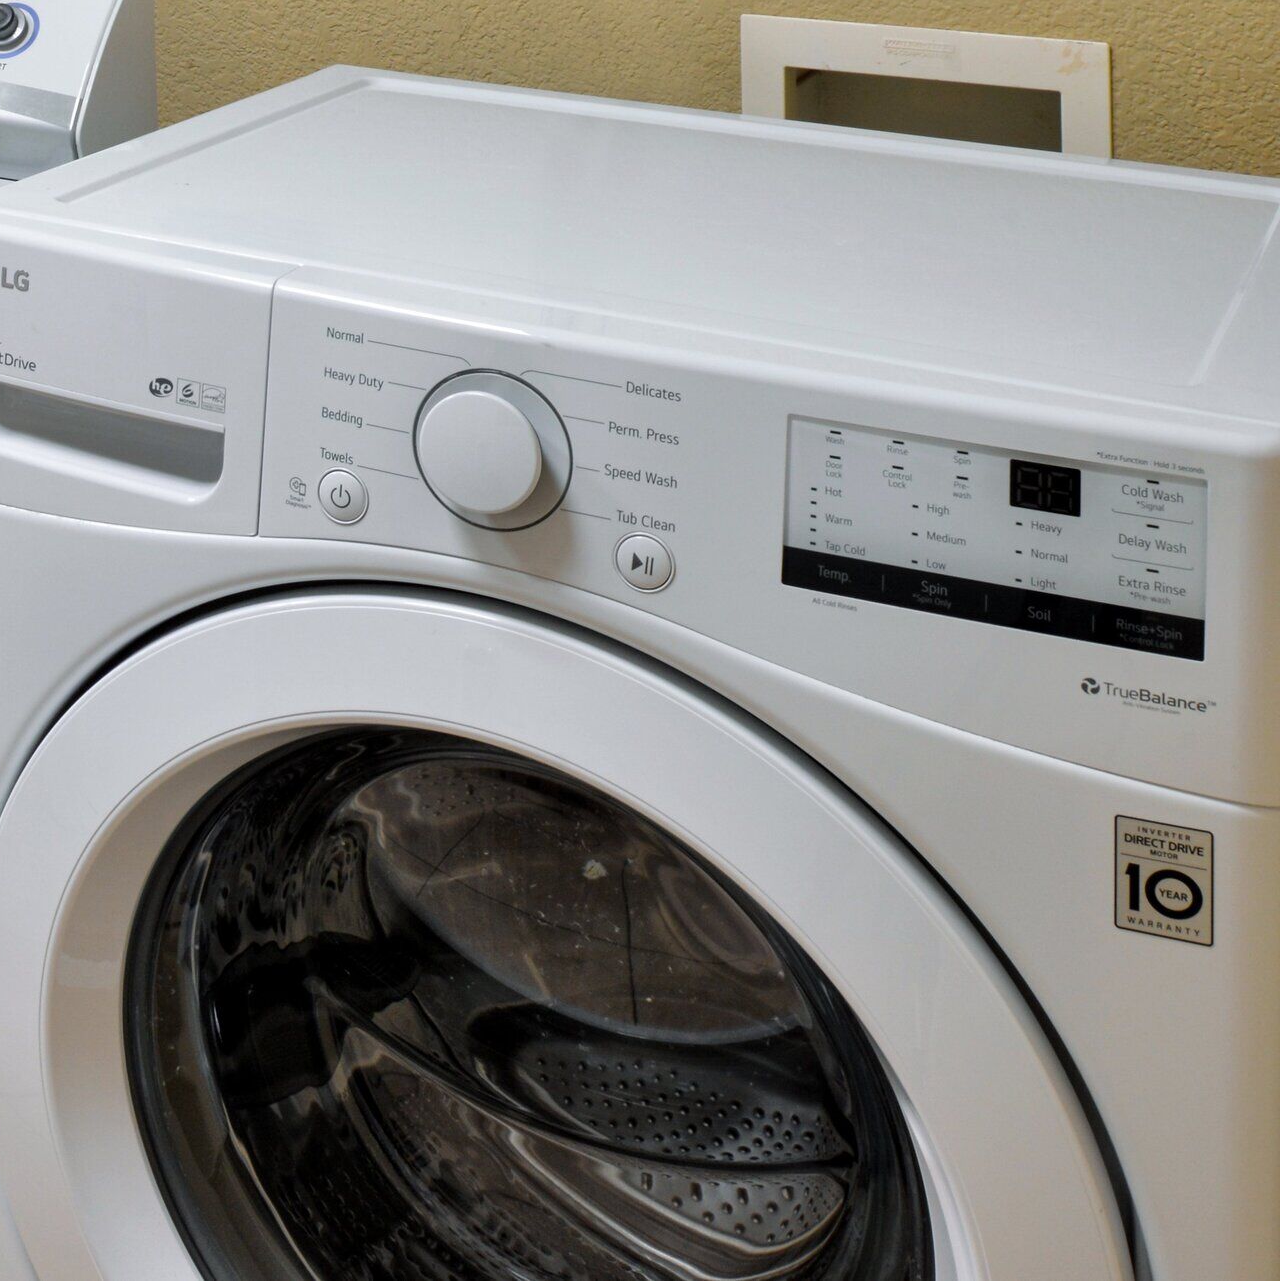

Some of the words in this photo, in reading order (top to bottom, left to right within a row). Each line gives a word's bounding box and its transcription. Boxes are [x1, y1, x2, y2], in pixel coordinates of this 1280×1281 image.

[1, 267, 30, 292] LG
[326, 327, 364, 344] Normal
[324, 367, 355, 386] Heavy
[358, 373, 384, 391] Duty
[626, 381, 682, 402] Delicates
[321, 406, 363, 428] Bedding
[608, 421, 642, 439] Perm.
[646, 428, 680, 446] Press
[825, 435, 845, 446] Wash
[320, 447, 354, 465] Towels
[887, 445, 909, 456] Rinse
[825, 460, 842, 469] Door
[953, 455, 971, 466] Spin
[1153, 460, 1170, 469] Hold
[604, 463, 641, 482] Speed
[645, 471, 678, 489] Wash
[825, 470, 842, 479] Lock
[882, 470, 912, 482] Control
[825, 486, 842, 498] Hot
[888, 479, 907, 489] Lock
[953, 480, 970, 491] Pre-
[952, 490, 972, 500] wash
[1121, 484, 1148, 498] Cold
[1152, 488, 1184, 504] Wash
[926, 503, 950, 517] High
[616, 509, 637, 526] Tub
[641, 514, 676, 533] Clean
[825, 513, 853, 526] Warm
[1031, 520, 1062, 536] Heavy
[926, 531, 967, 546] Medium
[1118, 533, 1152, 551] Delay
[1154, 538, 1187, 555] Wash
[825, 541, 841, 554] Tap
[843, 543, 866, 557] Cold
[1030, 548, 1069, 564] Normal
[926, 558, 946, 570] Low
[817, 565, 852, 584] Temp.
[921, 580, 948, 597] Spin
[1030, 577, 1057, 591] Light
[1118, 575, 1150, 591] Extra
[1154, 581, 1187, 597] Rinse
[822, 599, 837, 608] Cold
[934, 596, 952, 610] Only
[1027, 605, 1051, 623] Soil
[1116, 618, 1183, 641] Rinse+Spin
[1137, 826, 1191, 841] INVERTER
[1124, 833, 1166, 849] DIRECT
[1168, 841, 1204, 857] DRIVE
[1150, 849, 1178, 860] MOTOR
[1125, 862, 1203, 920] 10
[1159, 888, 1189, 902] YEAR
[1127, 916, 1200, 937] WARRANTY
